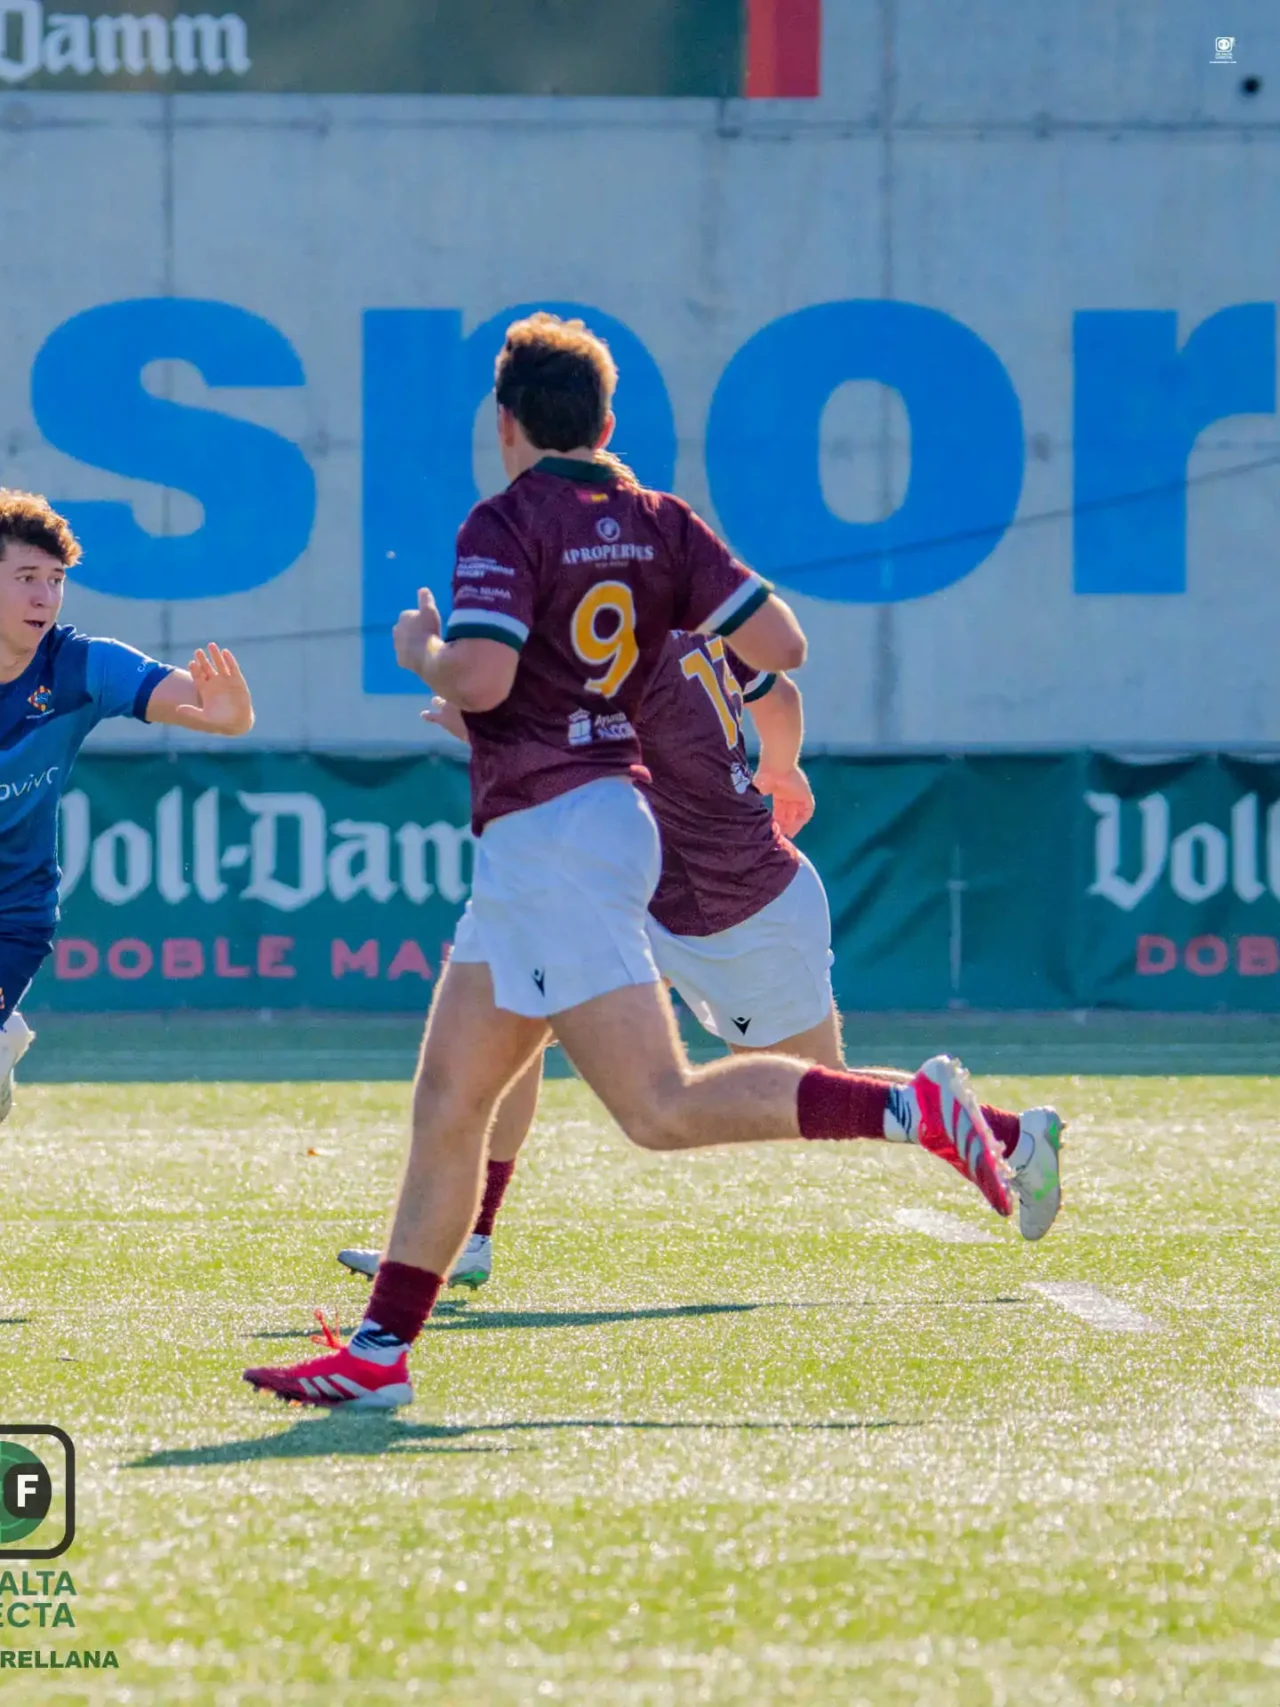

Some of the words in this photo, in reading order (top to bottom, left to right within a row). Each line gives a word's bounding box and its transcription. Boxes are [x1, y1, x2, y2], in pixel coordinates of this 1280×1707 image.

[570, 580, 640, 699] 9
[60, 785, 472, 912] oll-Dam
[55, 935, 297, 979] DOBLE
